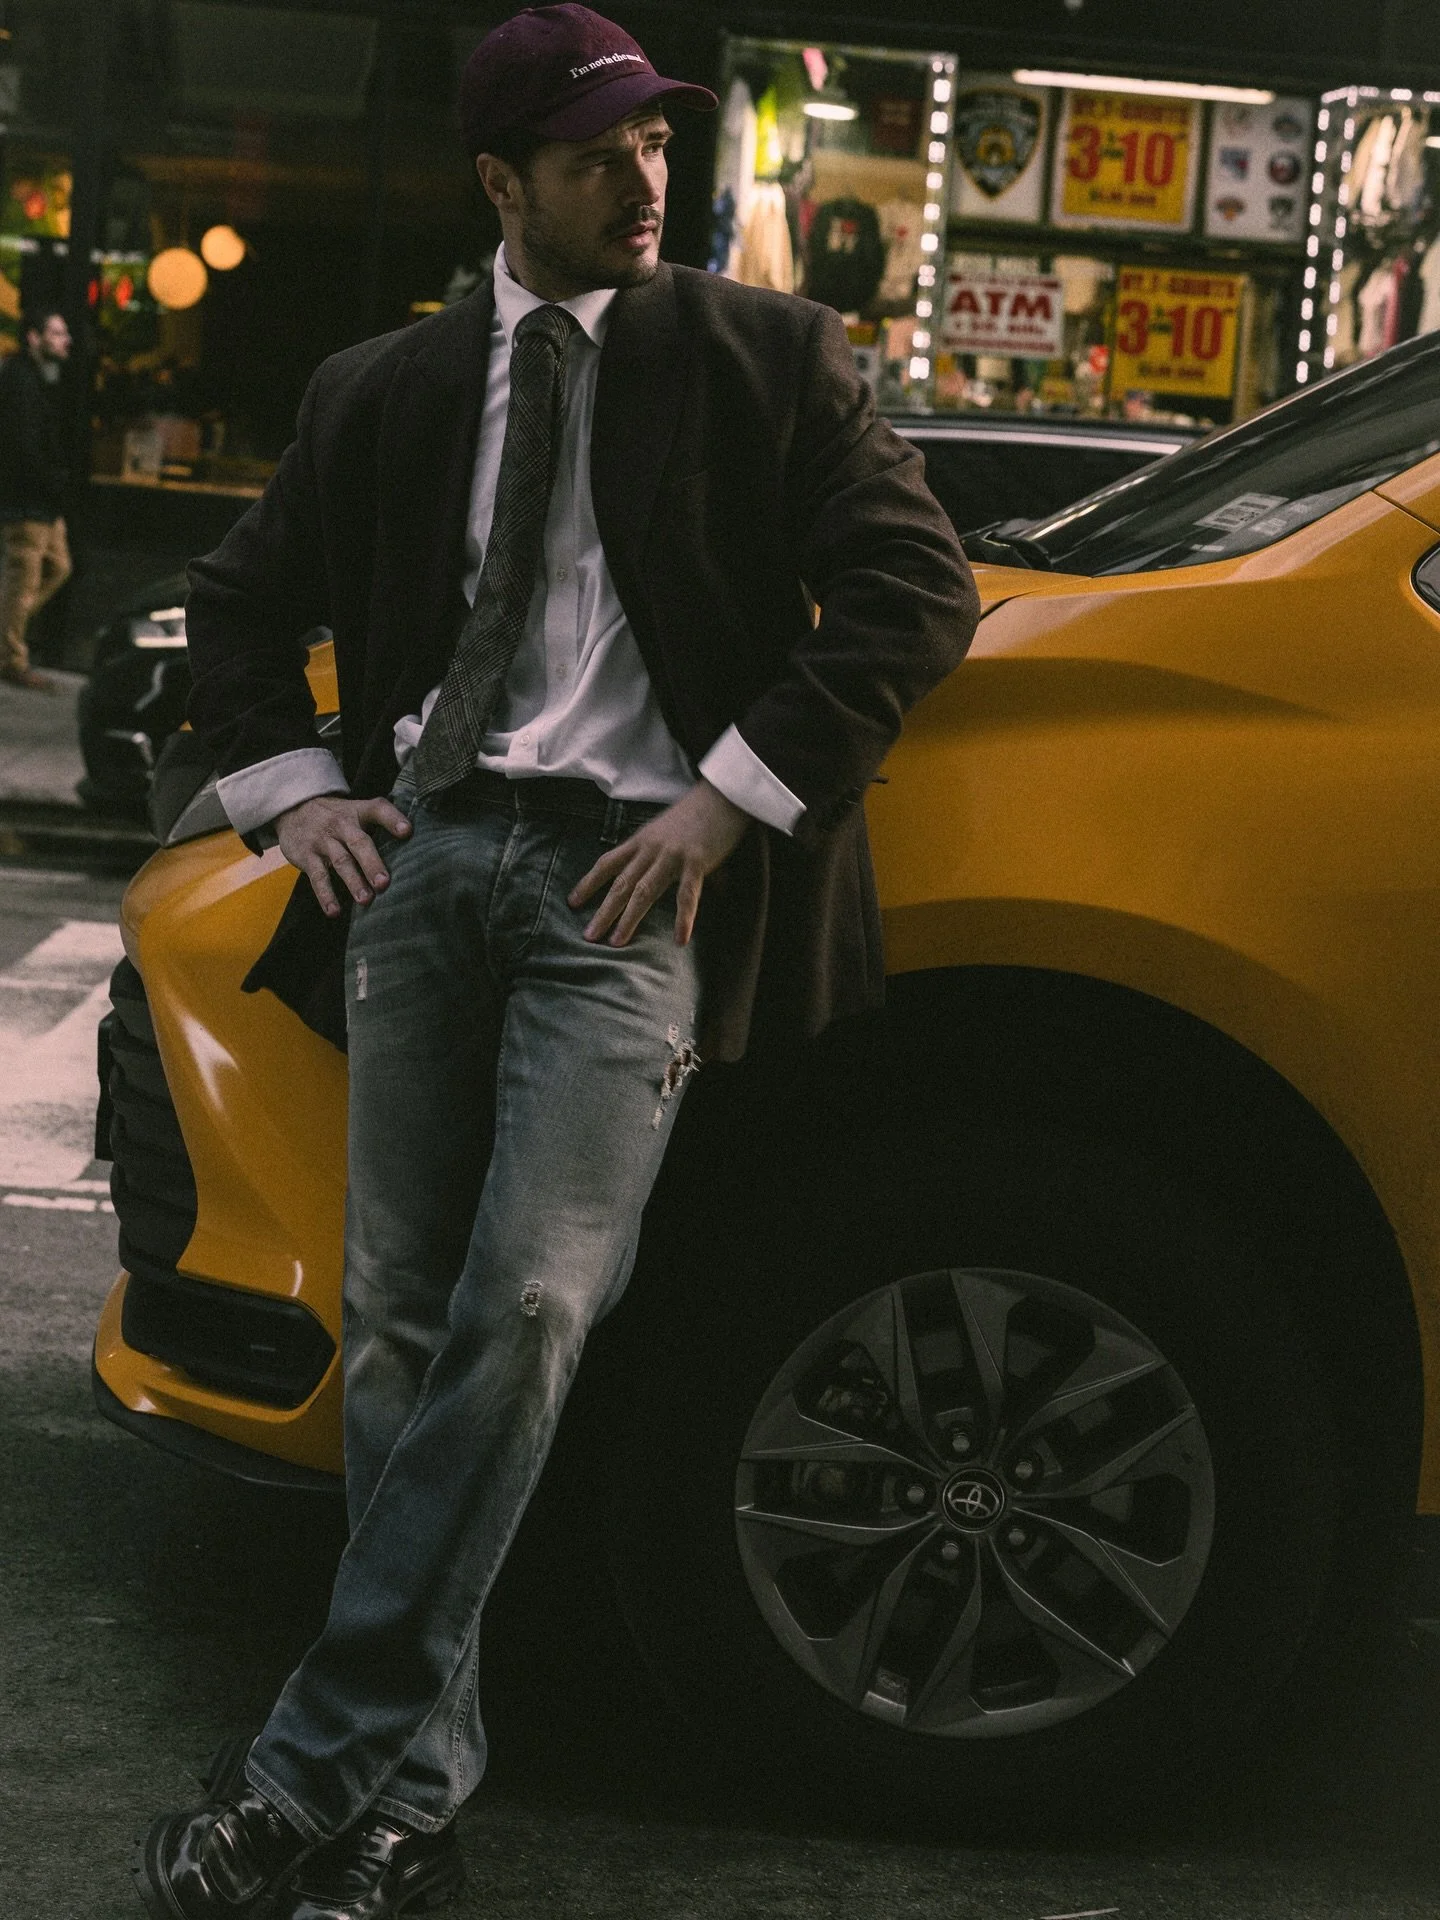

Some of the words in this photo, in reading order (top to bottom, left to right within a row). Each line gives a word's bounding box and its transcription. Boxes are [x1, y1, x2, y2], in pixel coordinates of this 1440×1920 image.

[569, 67, 590, 79] I'm
[588, 58, 605, 70] not
[603, 56, 614, 64] in
[612, 53, 627, 62] the
[1069, 125, 1100, 181] 3
[1119, 130, 1174, 186] 10
[949, 290, 1052, 321] ATM
[1118, 299, 1148, 355] 3
[1166, 304, 1221, 360] 10
